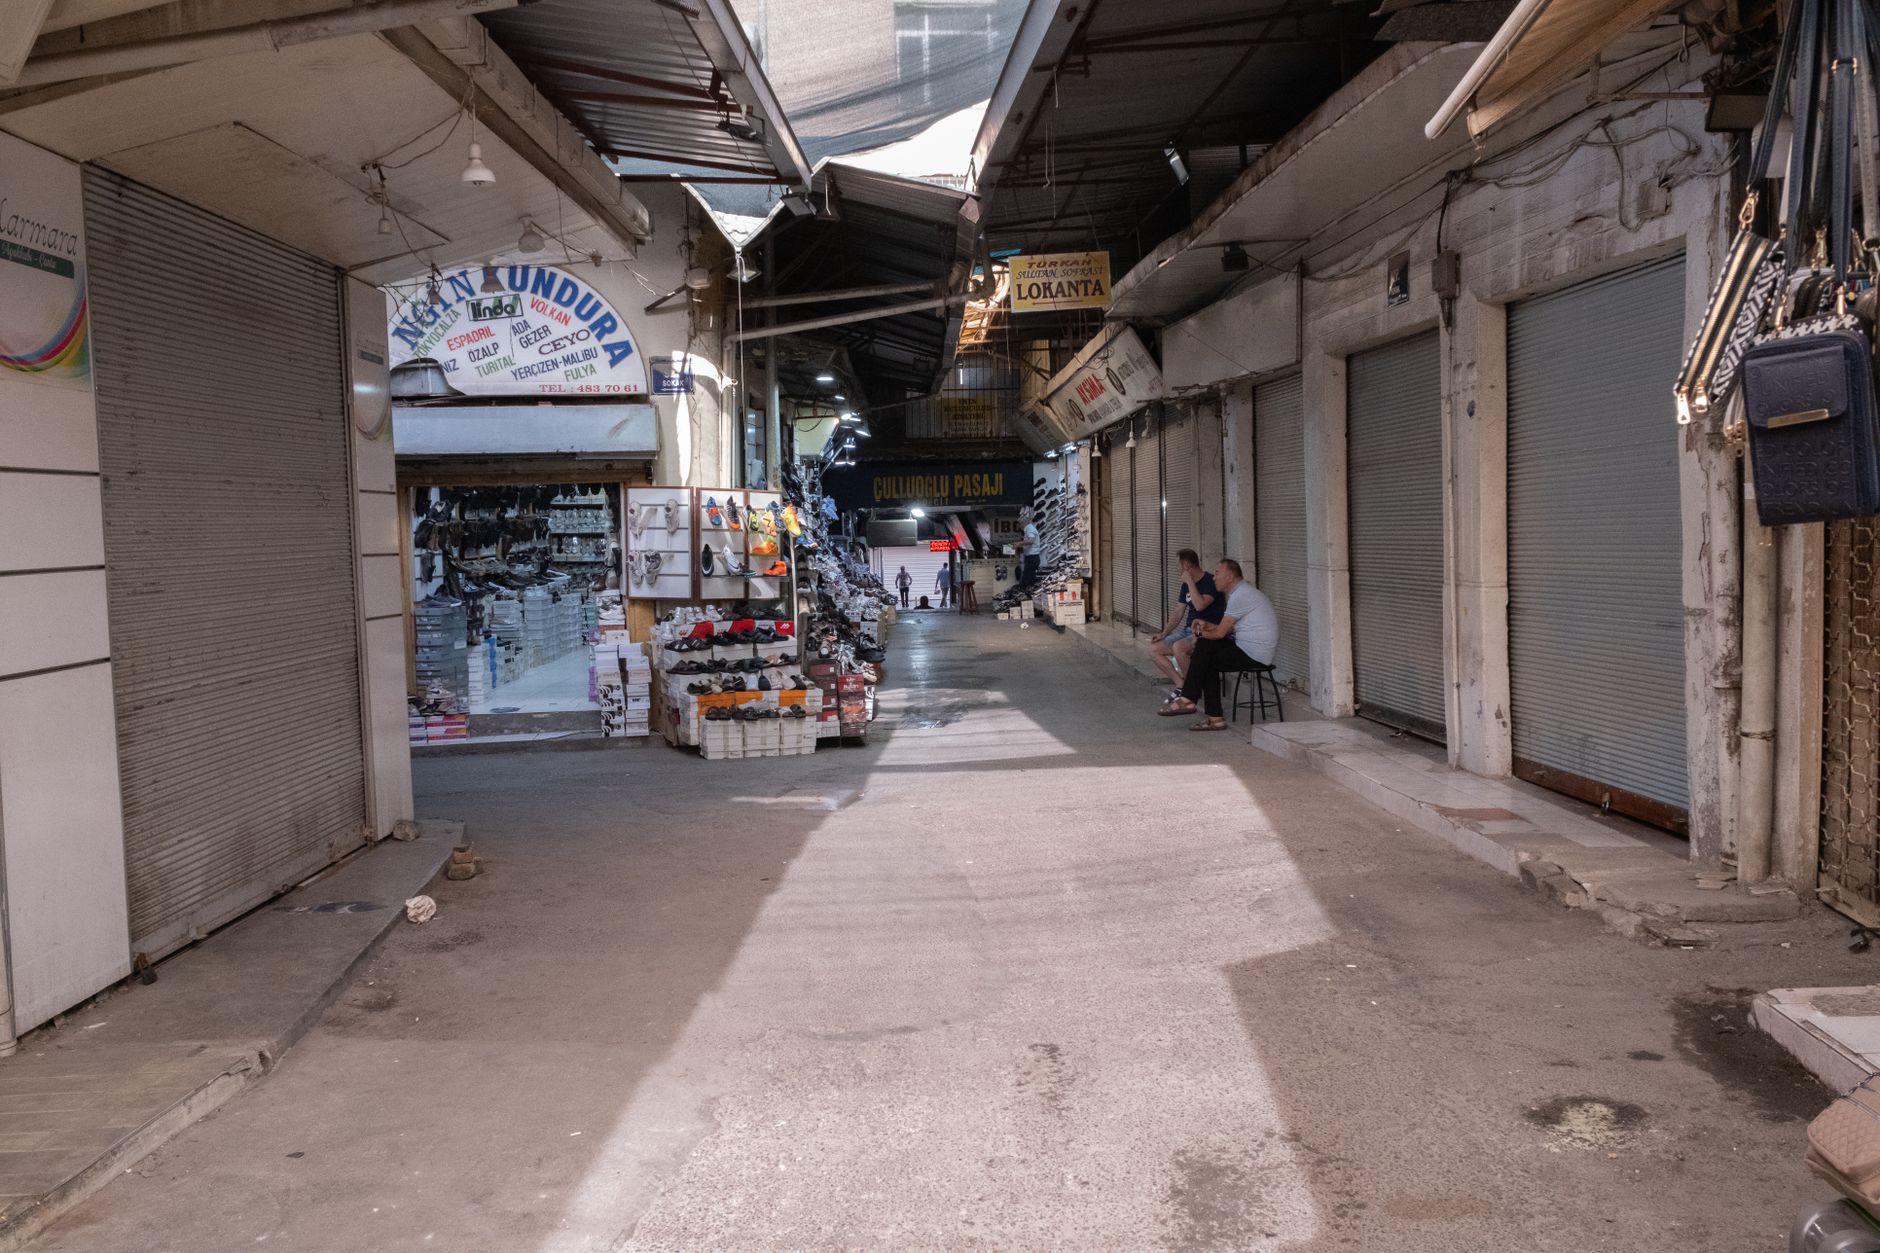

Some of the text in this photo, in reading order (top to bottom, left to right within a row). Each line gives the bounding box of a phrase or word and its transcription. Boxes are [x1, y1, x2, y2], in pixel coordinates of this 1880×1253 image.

[1016, 279, 1105, 301] LOKANTA
[530, 296, 572, 327] VOLKAN
[511, 319, 532, 337] ADA
[519, 325, 552, 349] GEZER
[538, 328, 591, 356] CEYO
[564, 363, 598, 383] FULYA
[576, 384, 601, 393] 483
[605, 384, 621, 393] 70
[624, 384, 639, 393] 61
